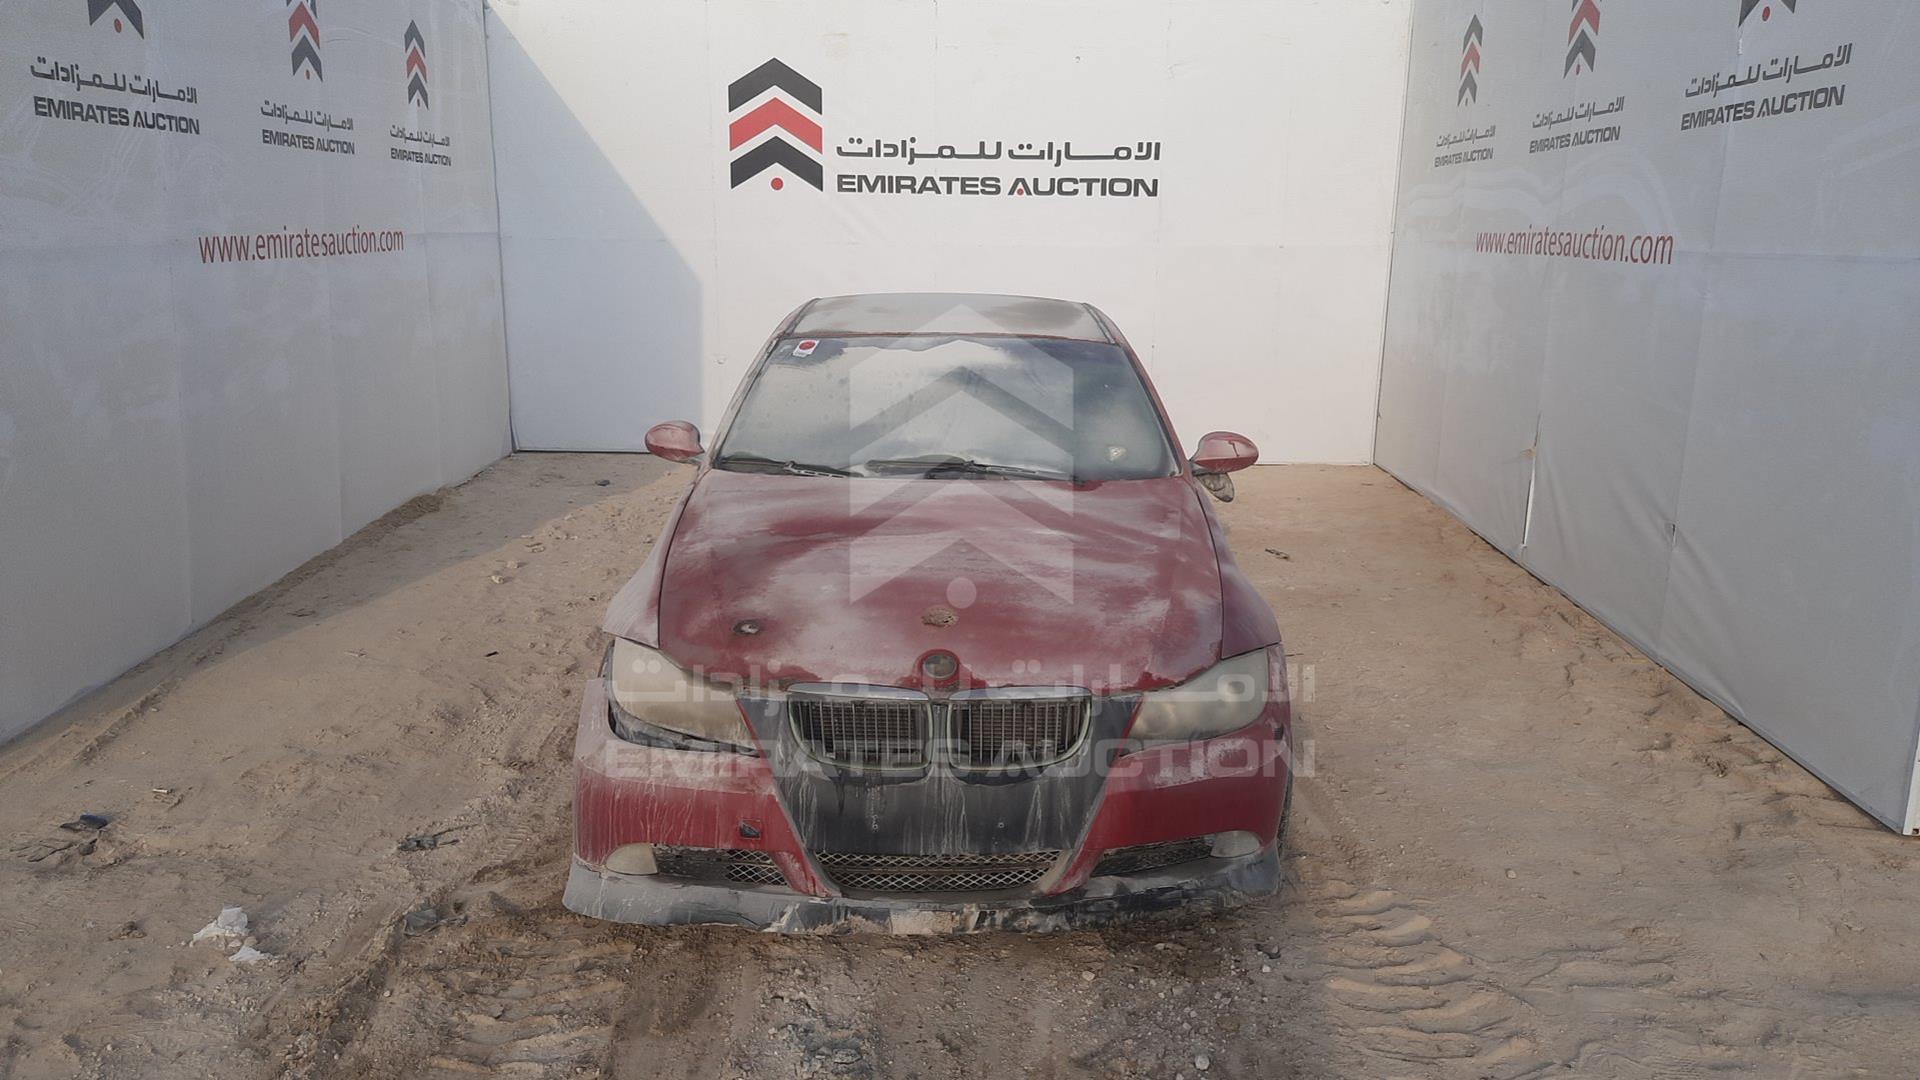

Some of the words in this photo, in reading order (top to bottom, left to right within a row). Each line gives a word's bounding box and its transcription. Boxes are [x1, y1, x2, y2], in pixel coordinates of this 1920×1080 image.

[33, 96, 130, 126] EMIRATES
[133, 110, 200, 135] AUCTION
[1680, 100, 1755, 131] EMIRATES
[1756, 84, 1846, 118] AUCTION
[262, 129, 315, 150] EMIRATES
[316, 138, 355, 155] AUCTION
[836, 137, 1001, 165] للمزادات
[1007, 141, 1161, 167] الامارات
[1529, 134, 1571, 154] EMIRATES
[1572, 126, 1621, 147] AUCTION
[391, 148, 424, 163] EMIRATES
[424, 152, 452, 166] AUCTION
[1434, 152, 1462, 168] EMIRATES
[1462, 148, 1494, 163] AUCTION
[836, 174, 1001, 196] EMIRATES
[1007, 178, 1159, 197] AUCTION
[198, 225, 404, 264] www.emiratesauction.com
[1475, 224, 1674, 265] www.emiratesauction.com
